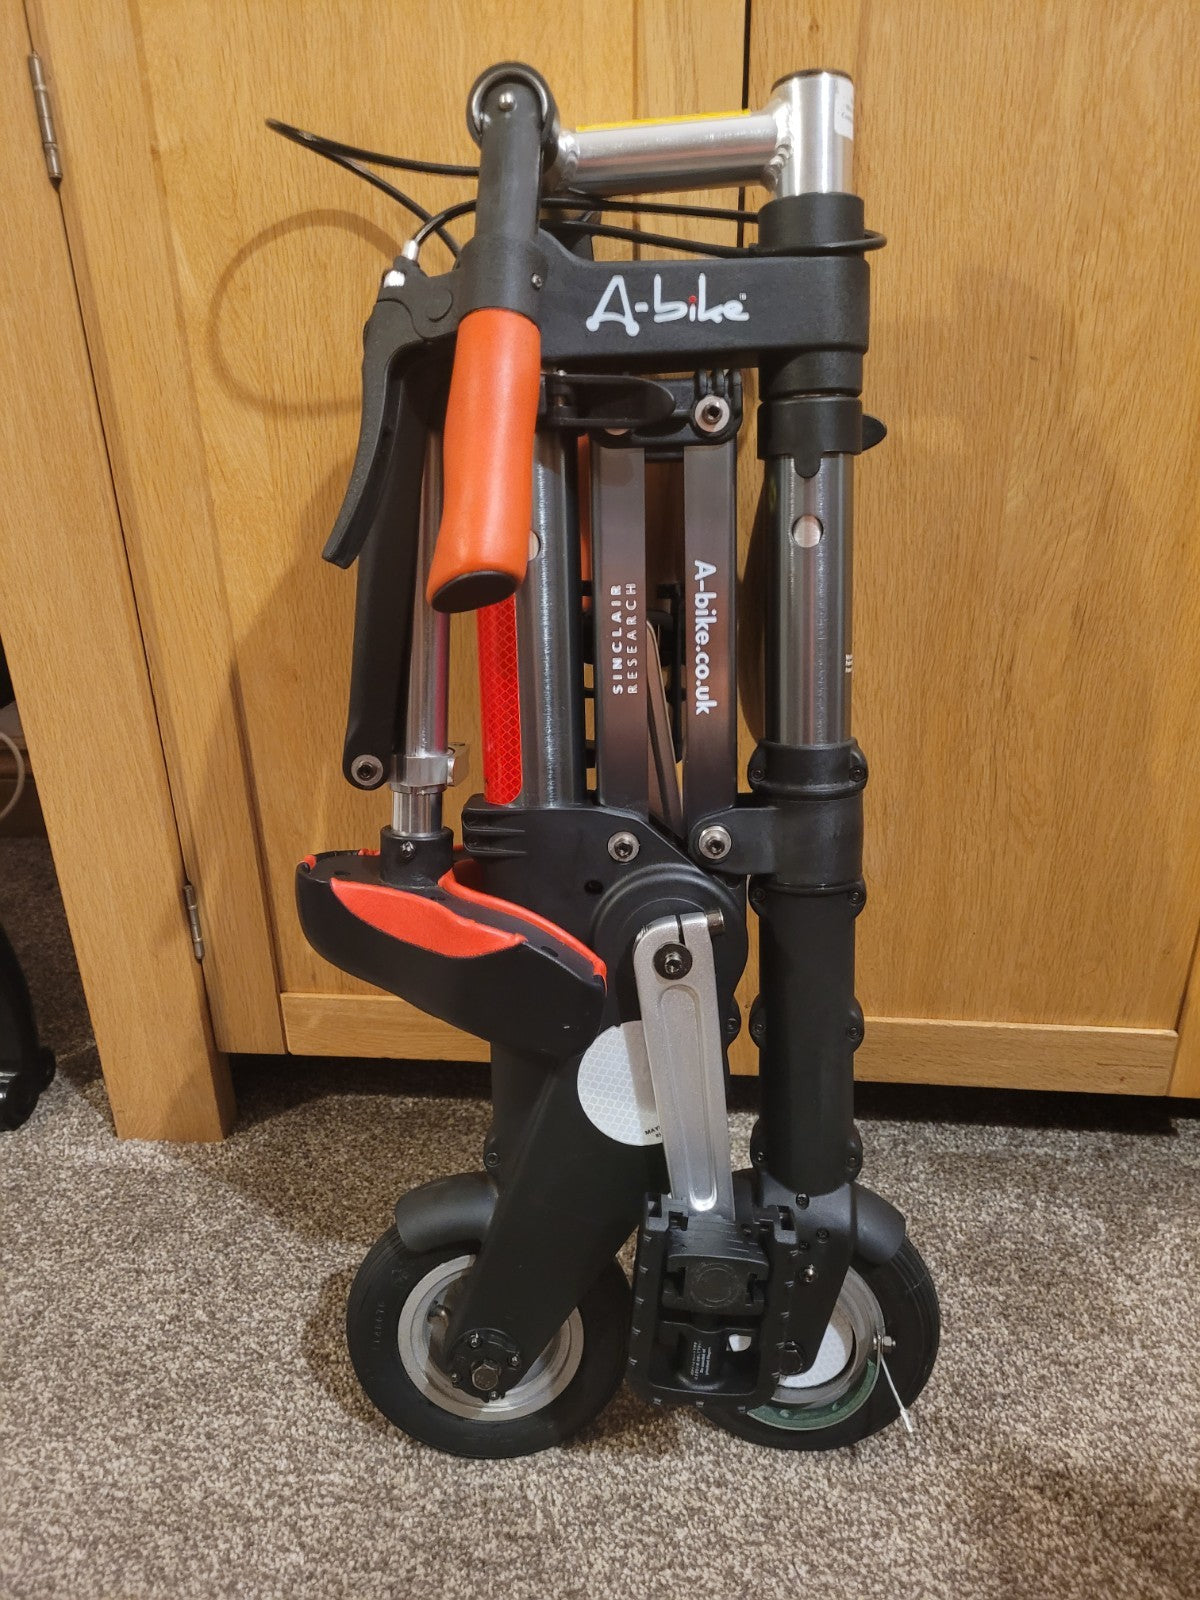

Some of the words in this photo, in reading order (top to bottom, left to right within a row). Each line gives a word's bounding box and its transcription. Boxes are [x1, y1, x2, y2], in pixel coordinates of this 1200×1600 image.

[586, 273, 749, 337] A-bike
[610, 584, 623, 694] SINCLAIR
[625, 583, 638, 694] RESEARCH
[694, 560, 717, 715] A-bike.co.uk
